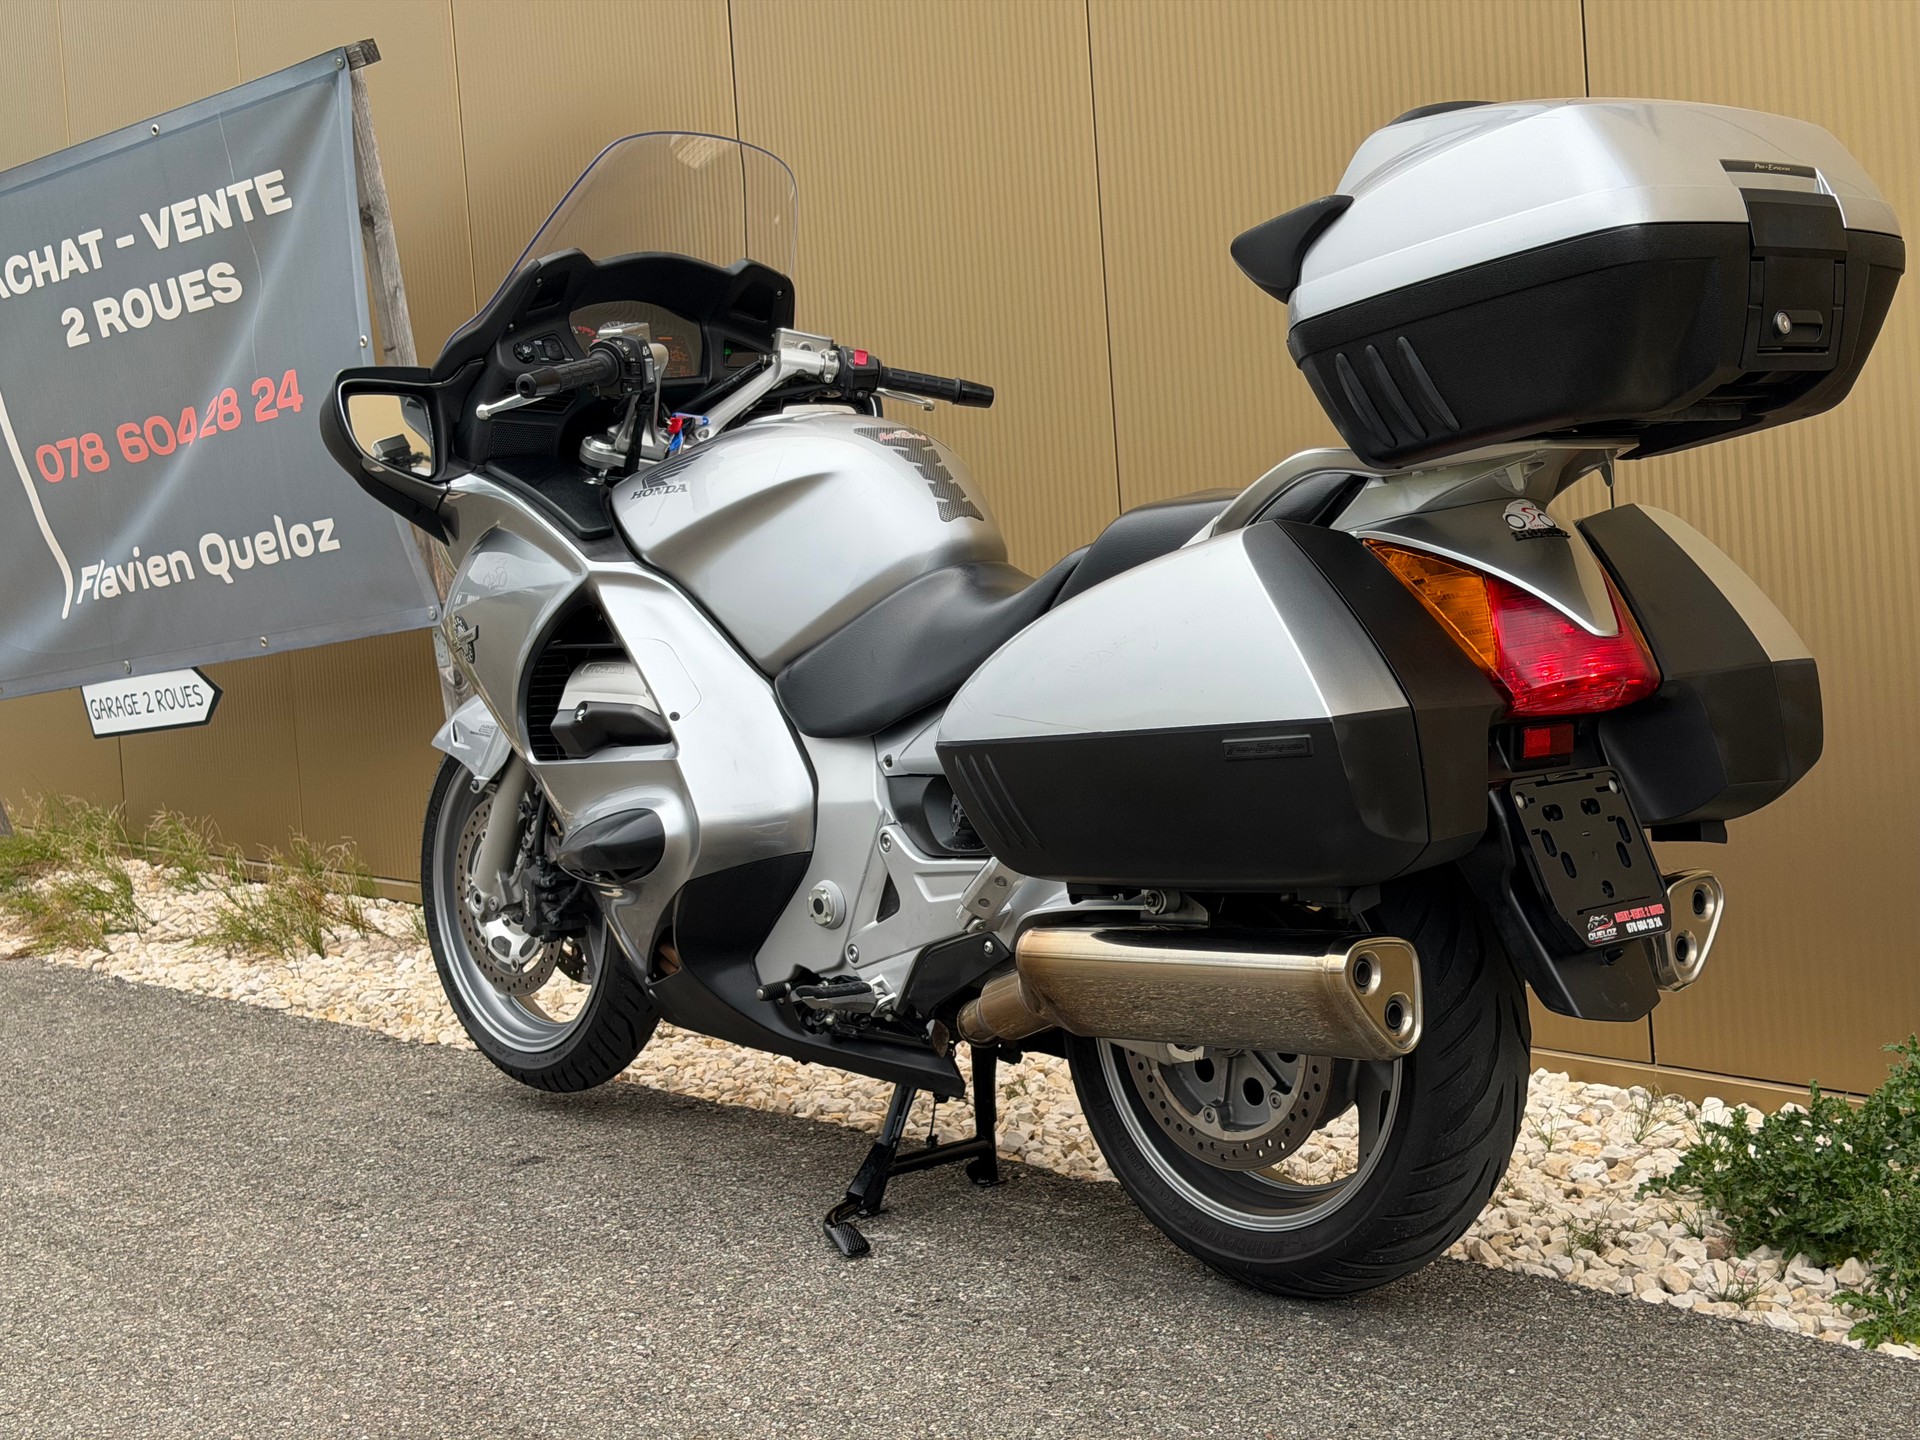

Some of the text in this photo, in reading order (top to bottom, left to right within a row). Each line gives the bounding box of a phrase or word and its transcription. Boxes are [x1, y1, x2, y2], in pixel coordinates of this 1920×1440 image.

[140, 169, 293, 250] VENTE
[61, 262, 243, 348] 2 ROUES
[35, 432, 110, 483] 078
[251, 369, 303, 422] 24
[630, 484, 688, 500] HONDA
[77, 514, 341, 604] Flavien Queloz
[90, 684, 204, 721] GARAGE 2 ROUES
[1588, 928, 1617, 940] QUELOZ
